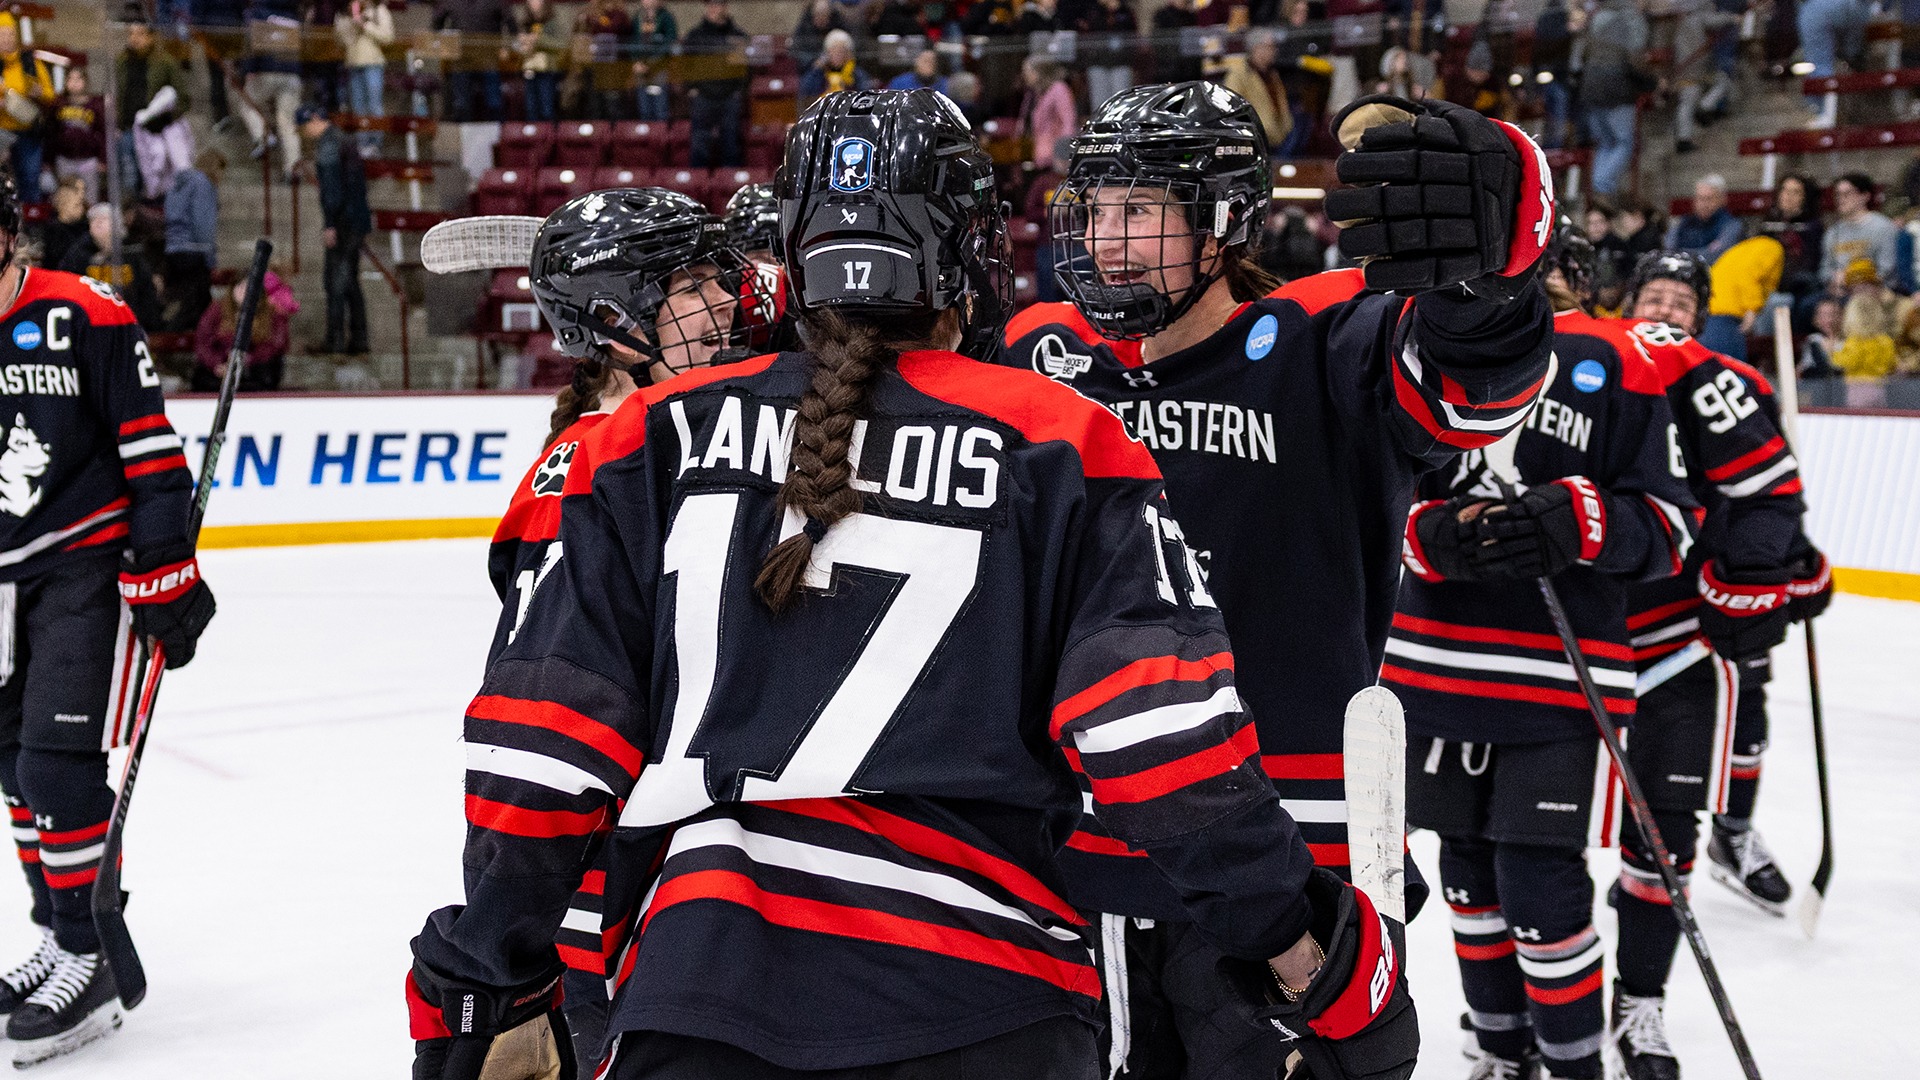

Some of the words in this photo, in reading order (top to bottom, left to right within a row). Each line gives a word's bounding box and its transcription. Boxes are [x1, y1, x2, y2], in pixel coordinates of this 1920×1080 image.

[1077, 143, 1123, 154] BAUER
[1214, 146, 1254, 156] BAUER
[843, 261, 872, 290] 17
[46, 306, 72, 350] C
[1250, 332, 1275, 350] NCAA
[1691, 368, 1760, 434] 92
[310, 430, 508, 485] HERE
[669, 395, 1004, 509] LANLOIS
[1142, 504, 1218, 609] 17
[617, 493, 984, 827] 17
[460, 993, 475, 1034] HUSKIES
